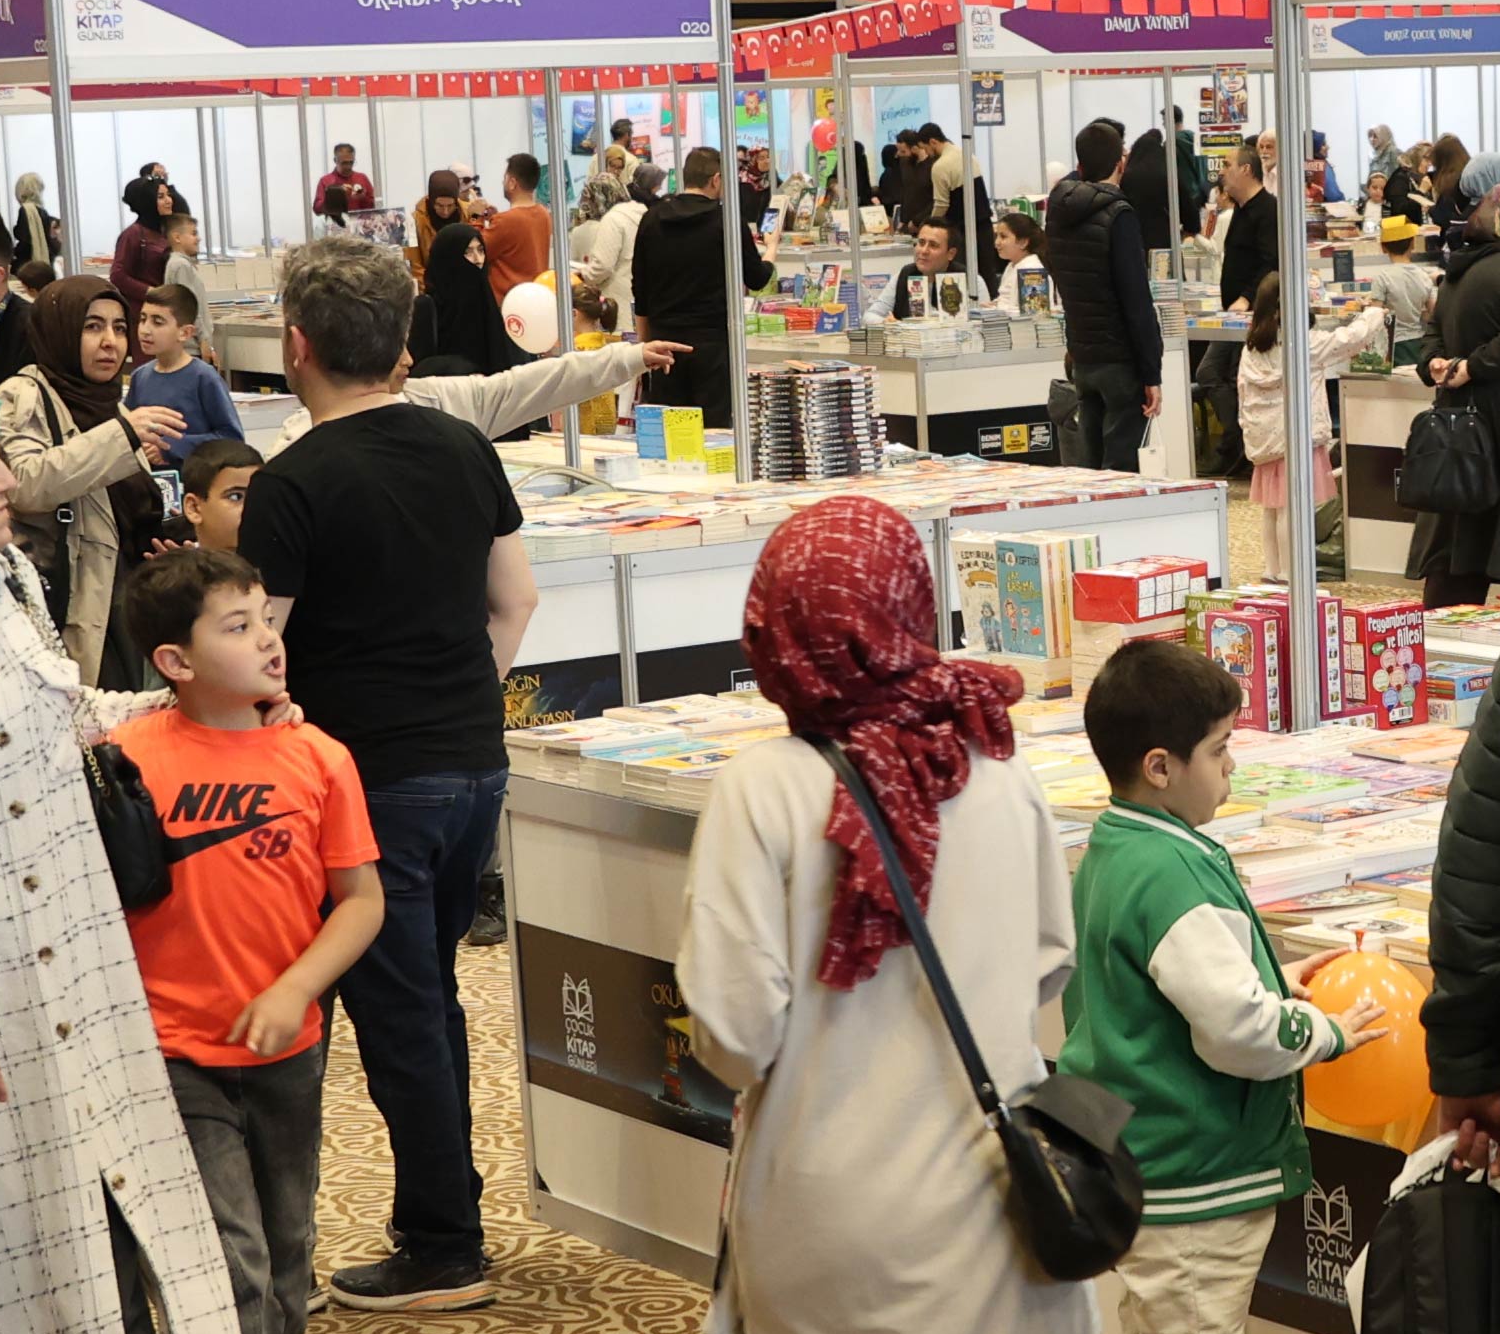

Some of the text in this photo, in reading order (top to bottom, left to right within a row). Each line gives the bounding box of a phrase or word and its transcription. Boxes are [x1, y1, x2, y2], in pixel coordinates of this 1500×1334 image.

[76, 0, 121, 13] ÇOCUK
[77, 11, 122, 28] KİTAP
[680, 21, 710, 35] 020
[1104, 12, 1190, 33] DAMLA YAYINEVİ
[77, 28, 124, 41] GÜNLERİ
[168, 783, 275, 823] NIKE
[243, 828, 293, 861] SB
[565, 1016, 596, 1039] ÇOCUK
[566, 1033, 597, 1060] KİTAP
[1306, 1233, 1354, 1262] ÇOCUK
